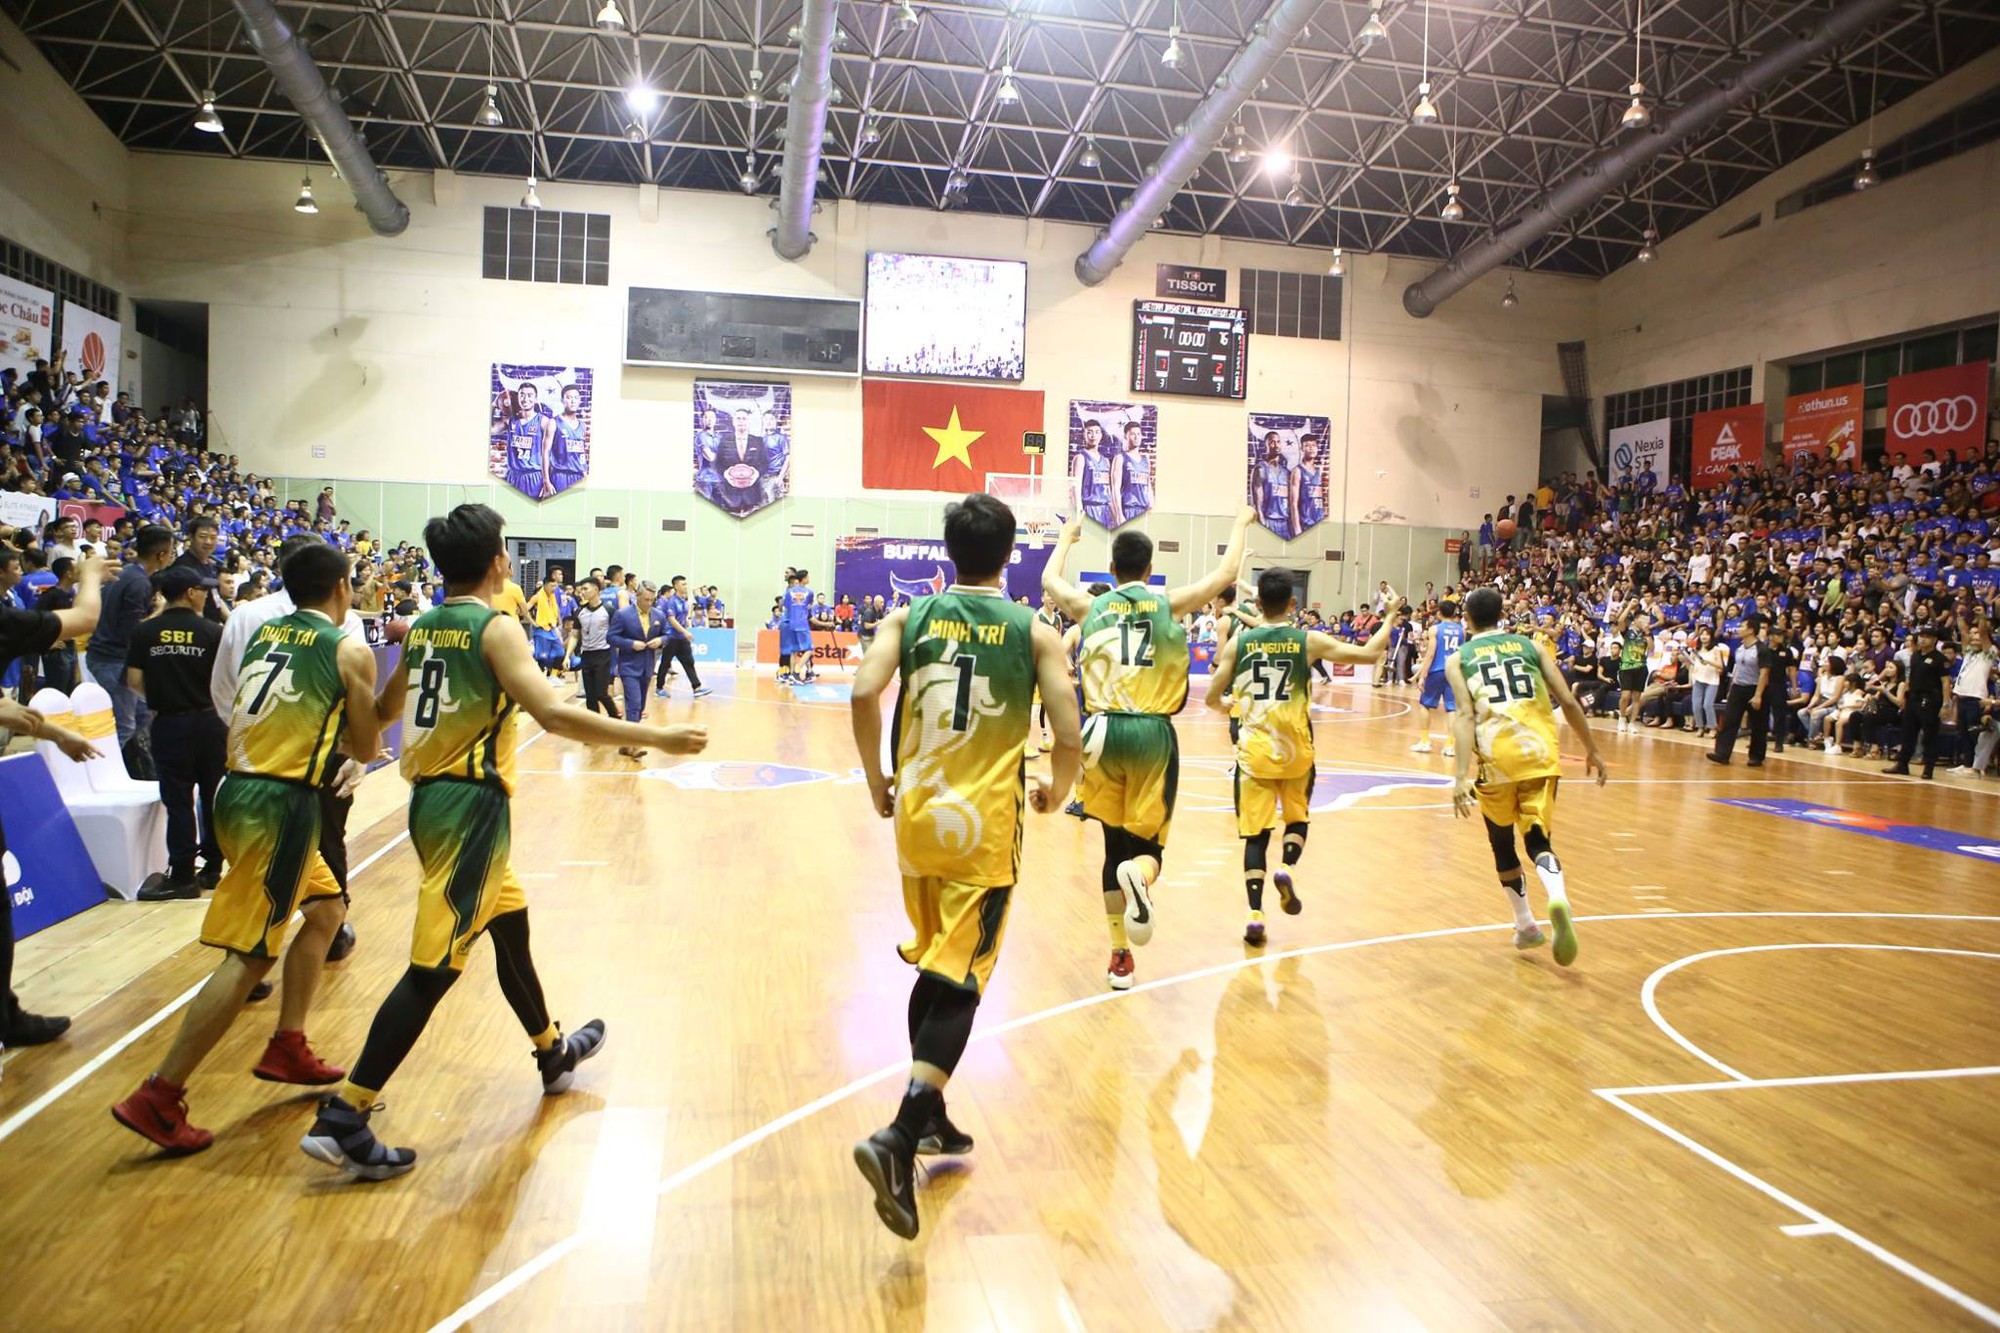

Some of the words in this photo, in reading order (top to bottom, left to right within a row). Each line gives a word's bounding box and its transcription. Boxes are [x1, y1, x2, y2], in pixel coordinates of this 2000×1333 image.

[1167, 279, 1216, 292] TISSOT
[11, 303, 38, 323] Châu
[1178, 331, 1206, 347] 00:00
[1187, 366, 1195, 378] 4
[1216, 362, 1223, 374] 2
[1635, 436, 1664, 453] Nexia
[1710, 444, 1742, 461] PEAK
[884, 544, 951, 562] BUFFAL
[160, 629, 194, 643] SBI
[928, 619, 972, 643] MINH
[977, 621, 1009, 645] TRÍ
[150, 644, 206, 657] SECURITY
[1116, 619, 1153, 667] 12
[1443, 635, 1458, 651] 14
[246, 651, 292, 715] 7
[1478, 657, 1534, 704] 56
[414, 658, 446, 729] 8
[951, 653, 976, 732] 1
[14, 886, 35, 906] ĐỘI
